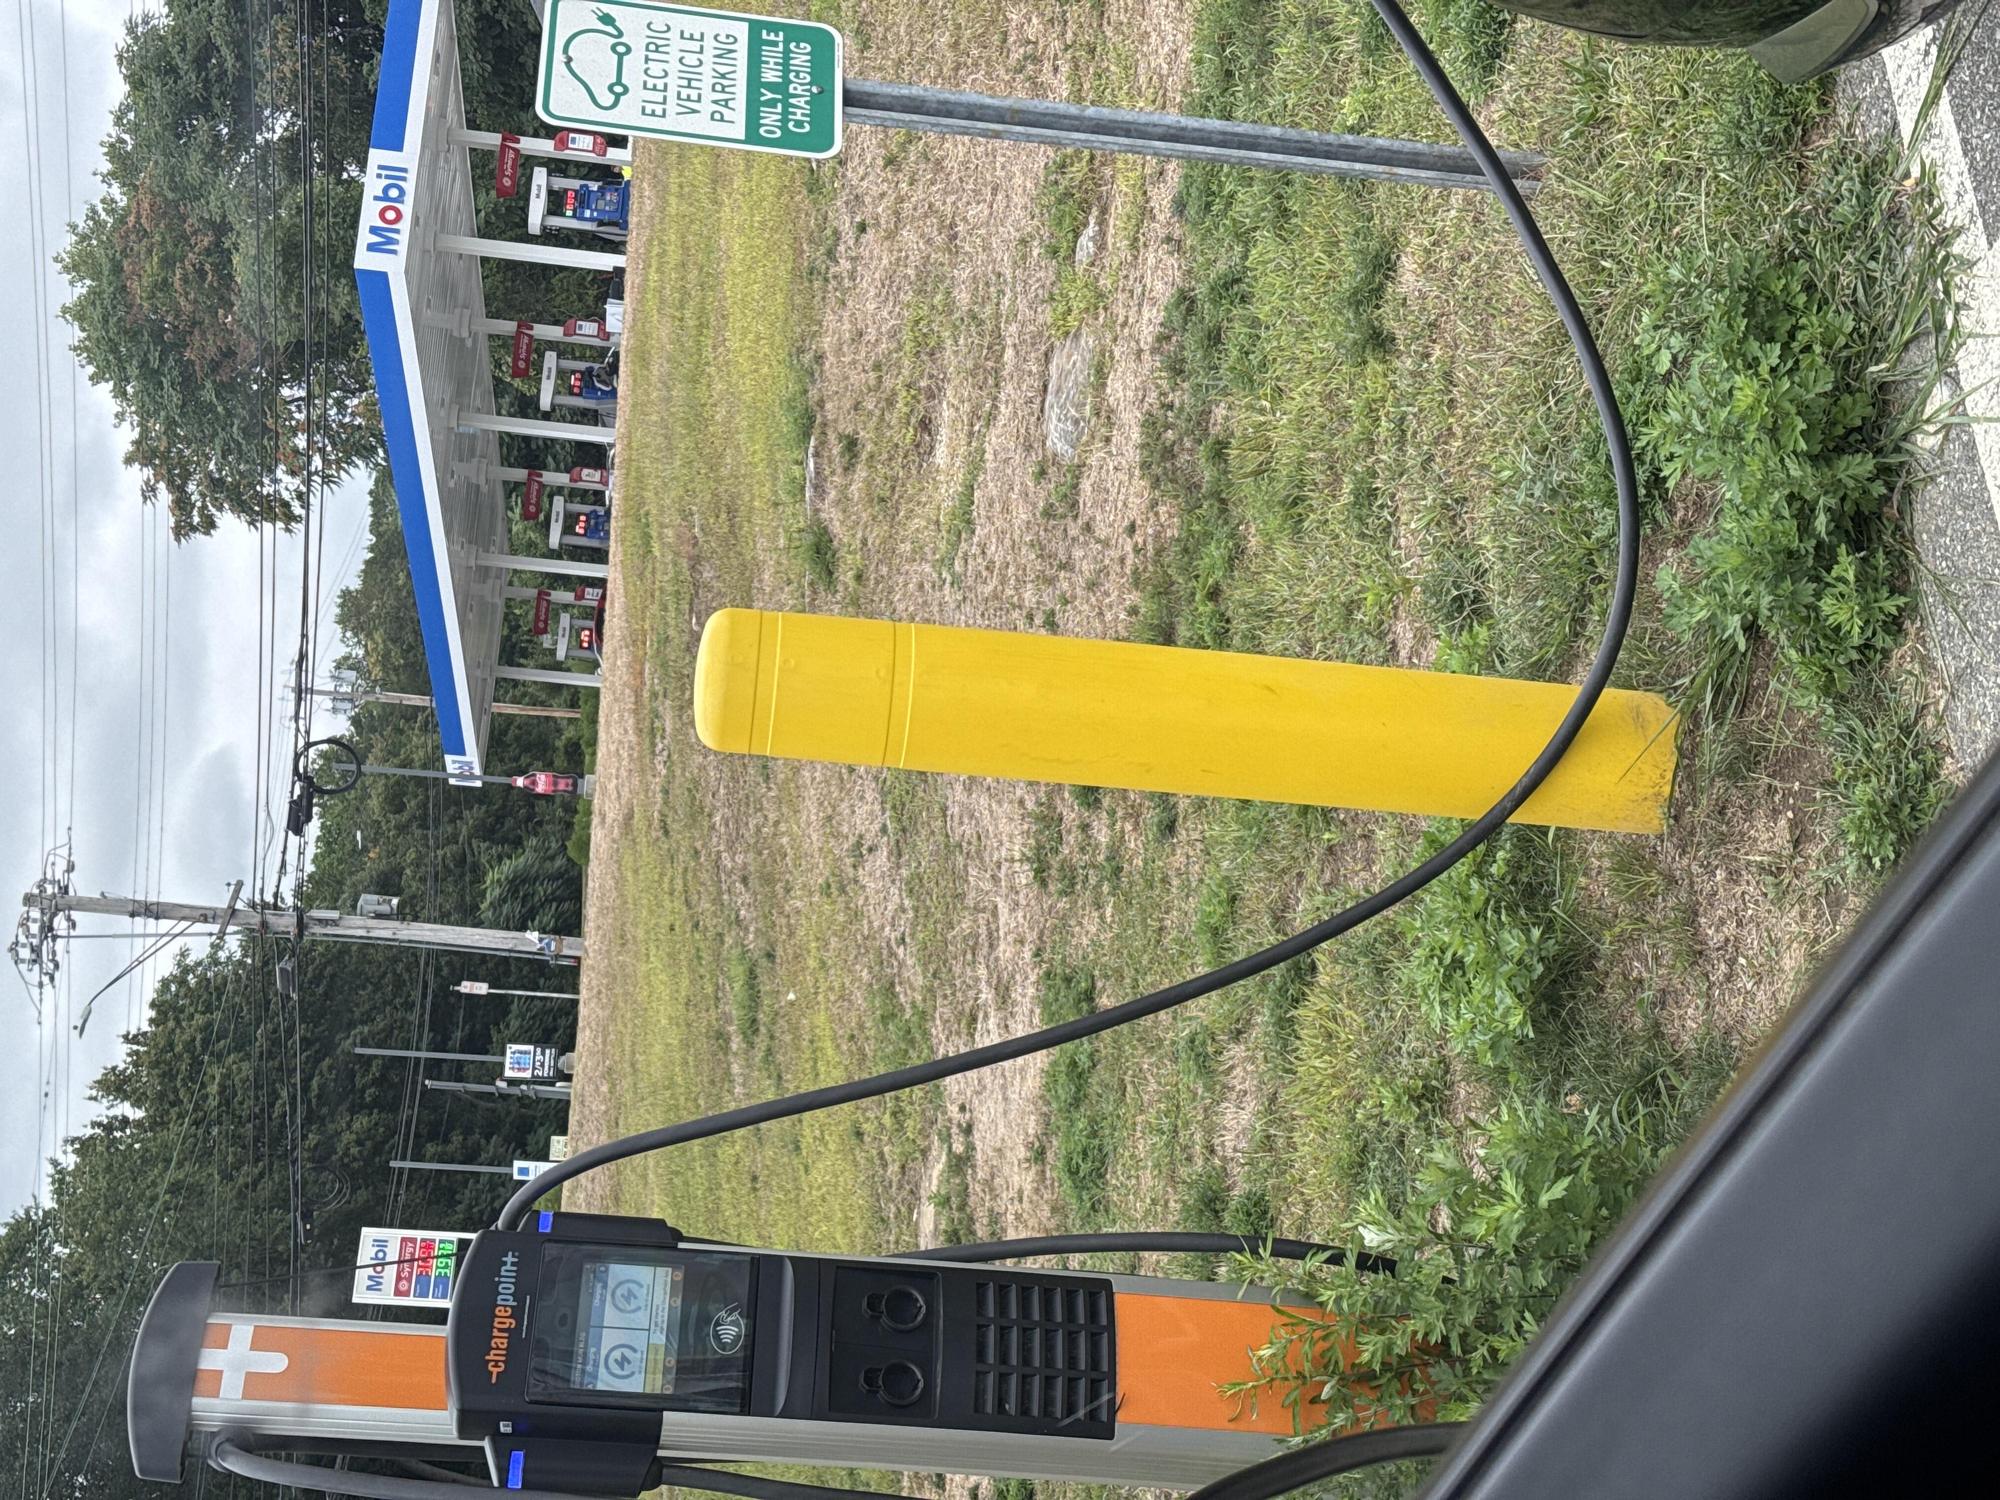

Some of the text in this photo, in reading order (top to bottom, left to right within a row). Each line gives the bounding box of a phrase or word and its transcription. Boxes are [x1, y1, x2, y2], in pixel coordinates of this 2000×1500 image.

[641, 20, 671, 119] ELECTRIC
[675, 29, 705, 116] VEHICLE
[710, 32, 739, 124] PARKING
[759, 28, 785, 139] ONLY WHILE
[787, 41, 812, 134] CHARGING
[504, 148, 515, 177] Synergy
[365, 164, 409, 256] Mobil
[365, 1238, 389, 1293] Mobil
